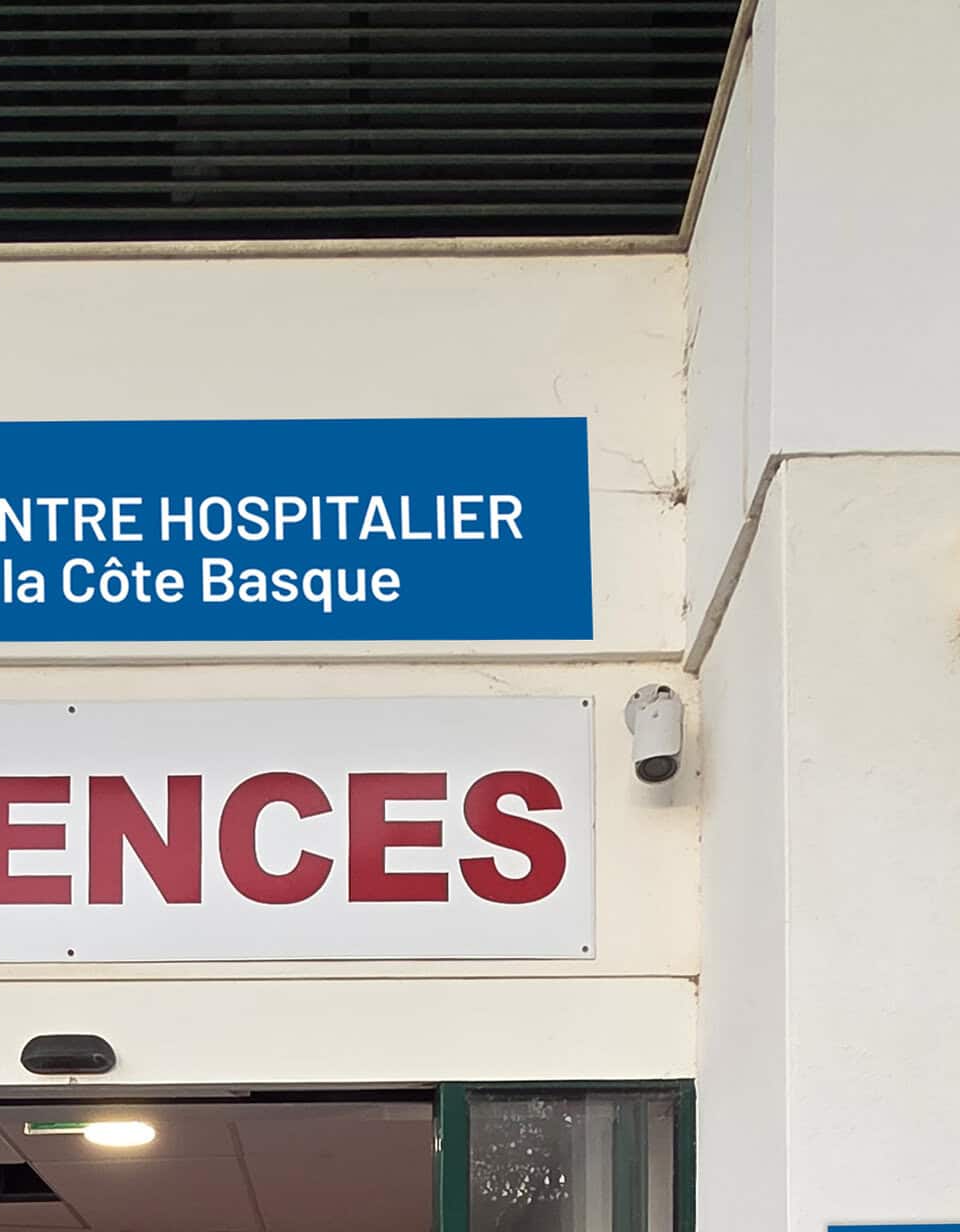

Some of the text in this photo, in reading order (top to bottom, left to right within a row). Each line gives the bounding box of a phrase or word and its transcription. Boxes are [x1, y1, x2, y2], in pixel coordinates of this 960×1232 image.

[160, 494, 524, 541] HOSPITALIER
[3, 559, 46, 603] la
[62, 556, 185, 603] Côte
[201, 557, 401, 614] Basque
